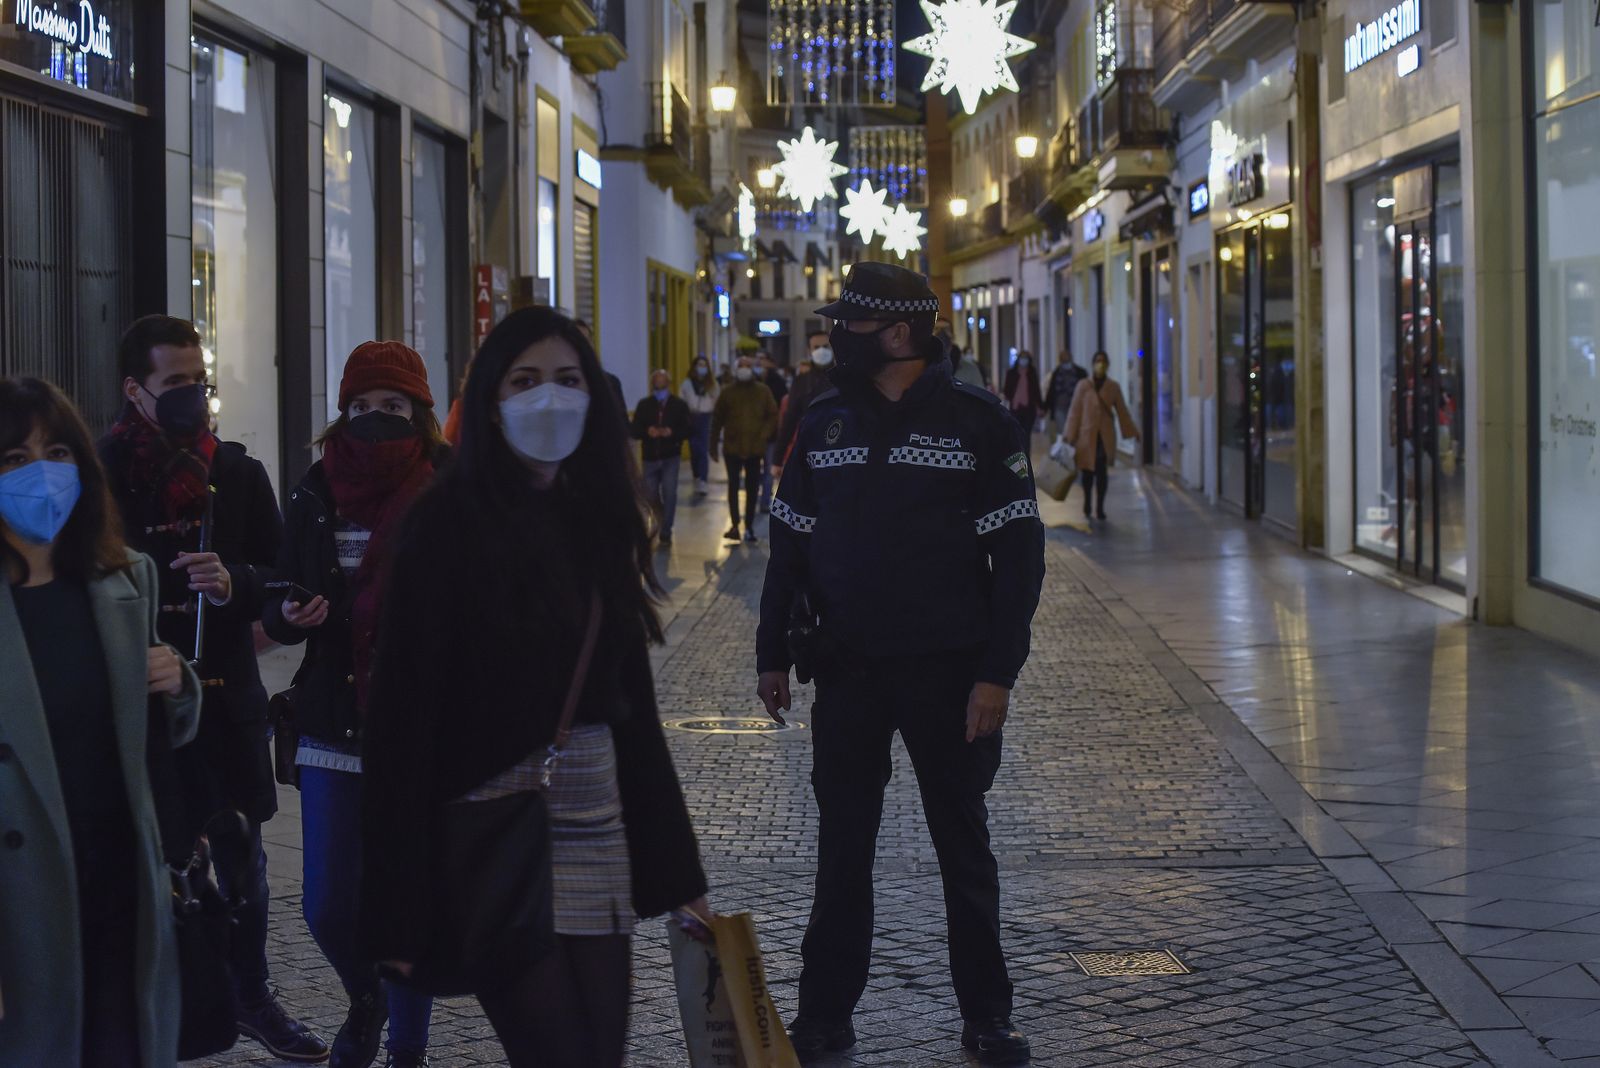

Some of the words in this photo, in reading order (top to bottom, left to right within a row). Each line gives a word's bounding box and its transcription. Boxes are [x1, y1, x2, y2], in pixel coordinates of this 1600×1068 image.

[15, 0, 78, 44] Massimo
[79, 0, 113, 59] Dutti
[1344, 0, 1421, 73] intimissimi
[478, 271, 490, 303] LA
[909, 433, 962, 448] POLICIA
[746, 957, 771, 1048] lush.com
